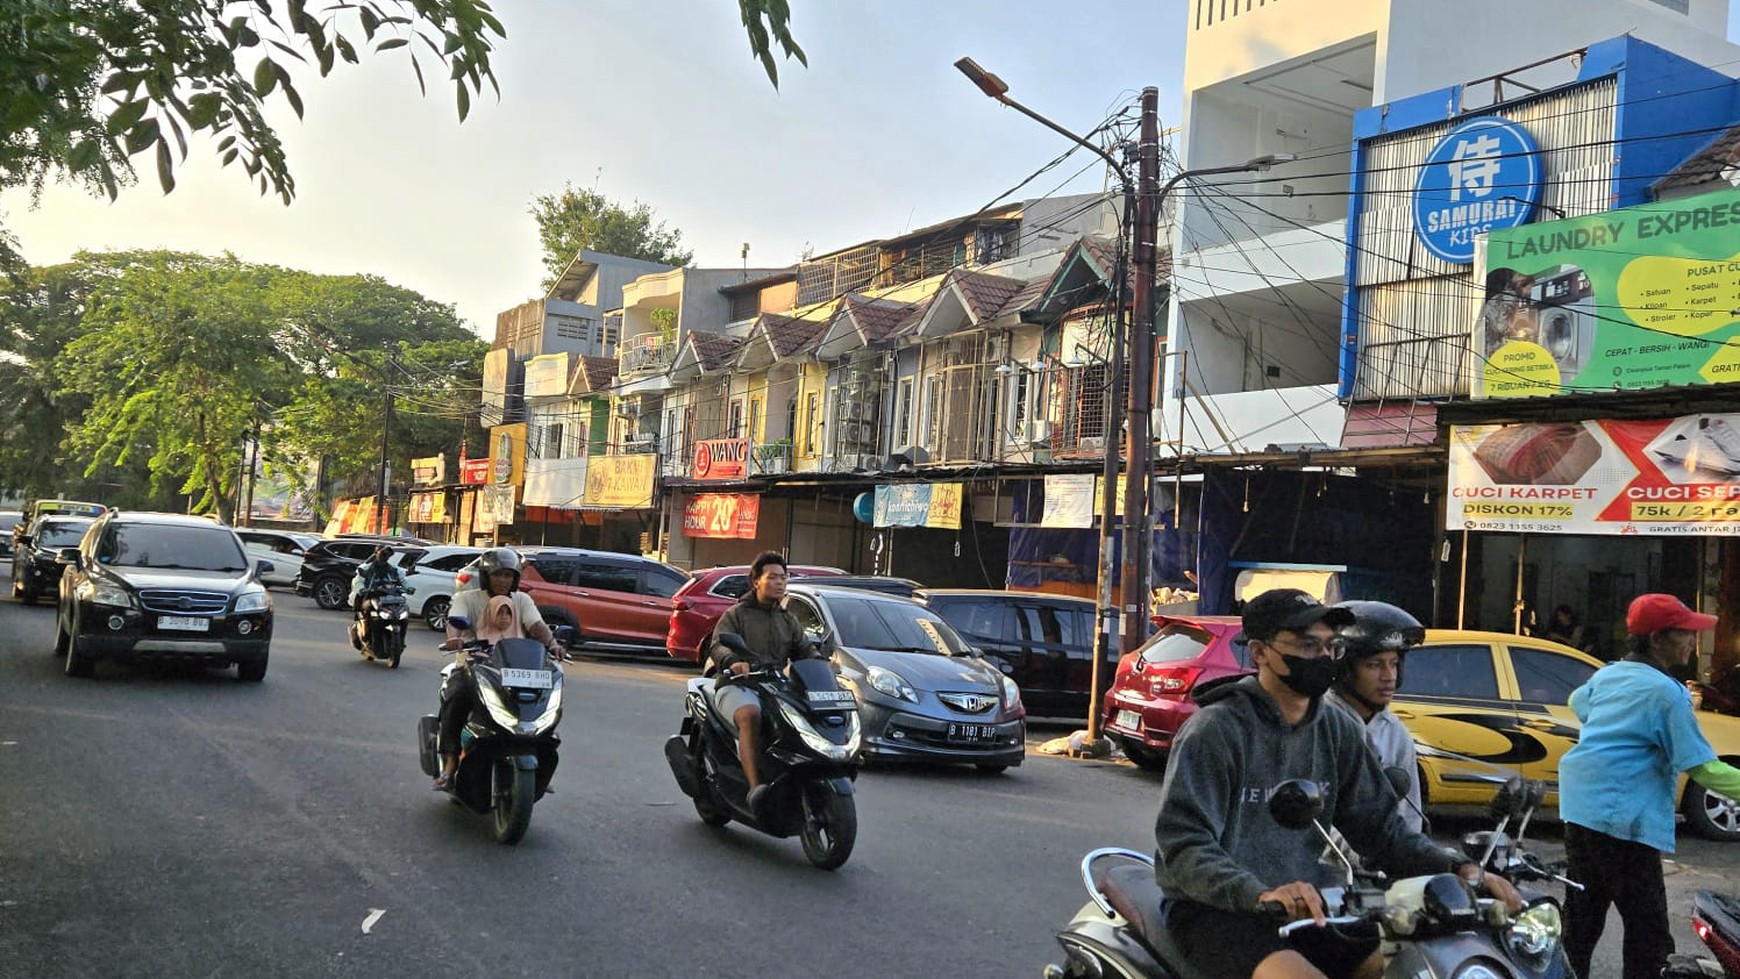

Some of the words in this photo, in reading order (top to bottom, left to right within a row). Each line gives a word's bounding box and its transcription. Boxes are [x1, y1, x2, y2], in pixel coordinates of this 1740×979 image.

[1448, 134, 1502, 202] 侍
[1427, 200, 1516, 233] SAMURAI
[1507, 222, 1624, 260] LAUNDRY
[1687, 265, 1725, 277] PUSAT
[1691, 282, 1719, 291] Sepatu
[1690, 296, 1717, 305] Karpet
[1605, 347, 1632, 357] CEPAT
[1640, 344, 1671, 354] BERSIH
[1678, 340, 1710, 350] WANGI
[1503, 352, 1536, 362] PROMO
[711, 442, 747, 462] WANG
[1452, 487, 1503, 498] CUCI
[1510, 488, 1599, 500] KARPET
[1627, 486, 1690, 499] CUCI
[1463, 504, 1533, 515] DISKON
[1540, 506, 1573, 516] 17%
[1637, 506, 1671, 516] 75k
[1693, 506, 1705, 516] 2
[684, 515, 706, 530] HOUR
[1479, 522, 1506, 530] 0823
[1509, 523, 1534, 531] 1155
[950, 725, 956, 735] B
